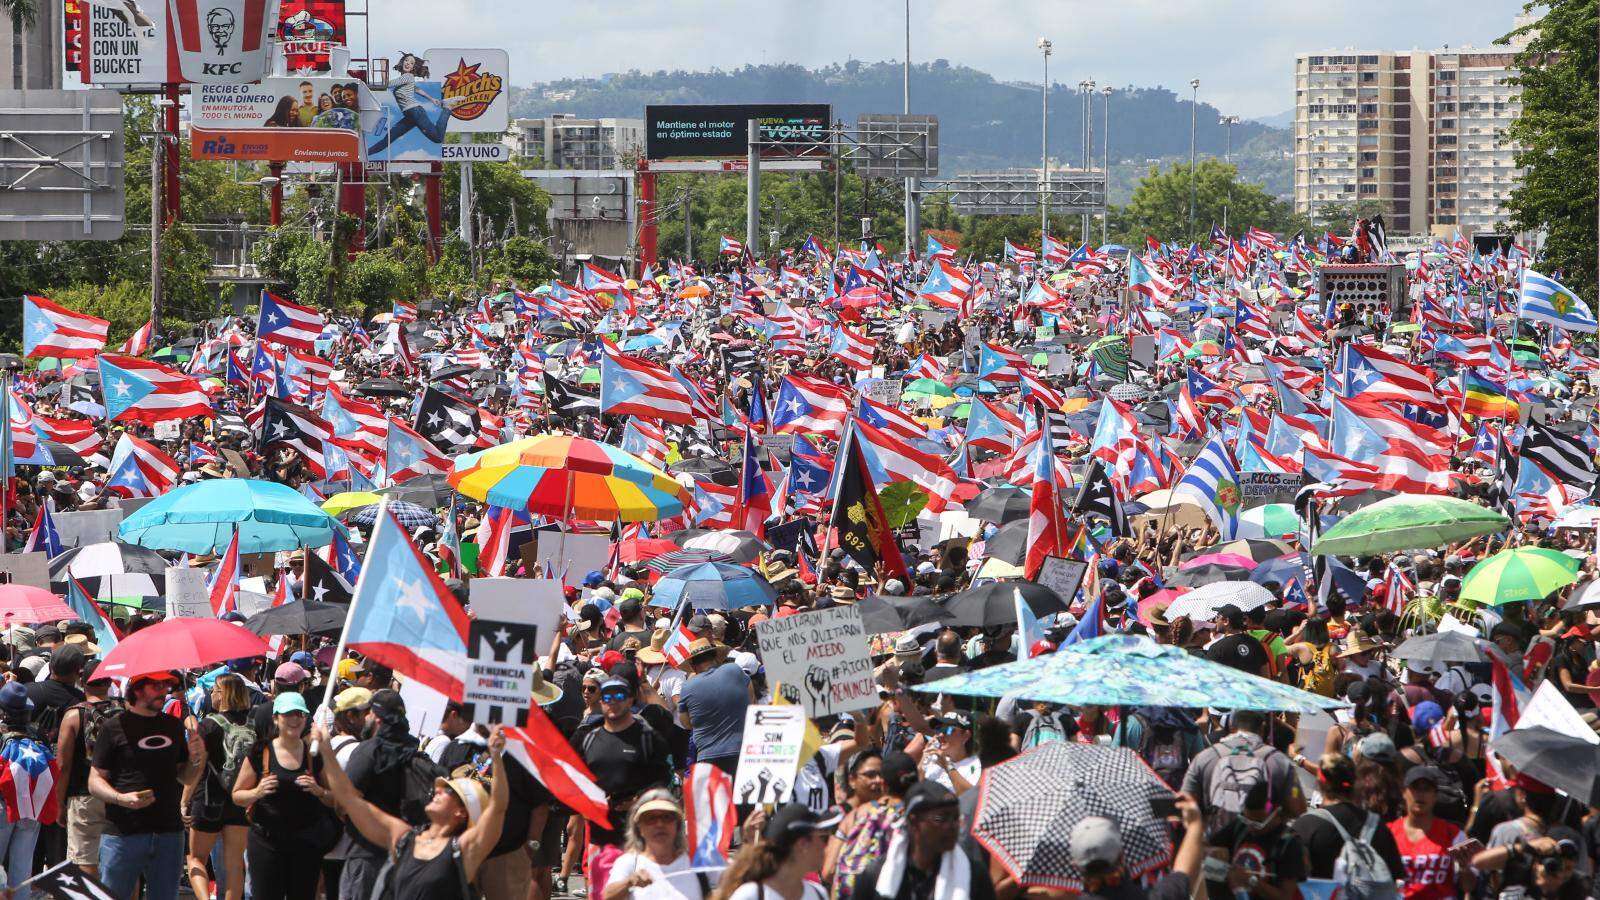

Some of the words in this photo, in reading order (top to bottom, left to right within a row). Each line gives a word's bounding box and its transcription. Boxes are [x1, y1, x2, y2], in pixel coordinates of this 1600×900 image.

[93, 41, 118, 56] CON
[122, 41, 138, 56] UN
[93, 58, 141, 74] BUCKET
[202, 62, 242, 75] KFC
[202, 84, 239, 93] RECIBE
[241, 85, 249, 93] O
[202, 94, 233, 103] ENVIA
[235, 94, 275, 103] DINERO
[656, 120, 697, 129] Mantiene
[699, 120, 707, 129] el
[708, 121, 736, 129] motor
[656, 131, 668, 139] en
[669, 130, 701, 140] óptimo
[702, 130, 732, 138] estado
[202, 135, 236, 155] Ria
[845, 531, 866, 552] 692
[761, 637, 784, 653] QUE
[787, 631, 807, 647] NOS
[782, 649, 797, 665] EL
[806, 642, 846, 661] MIEDO
[831, 677, 877, 705] RENUNCIA
